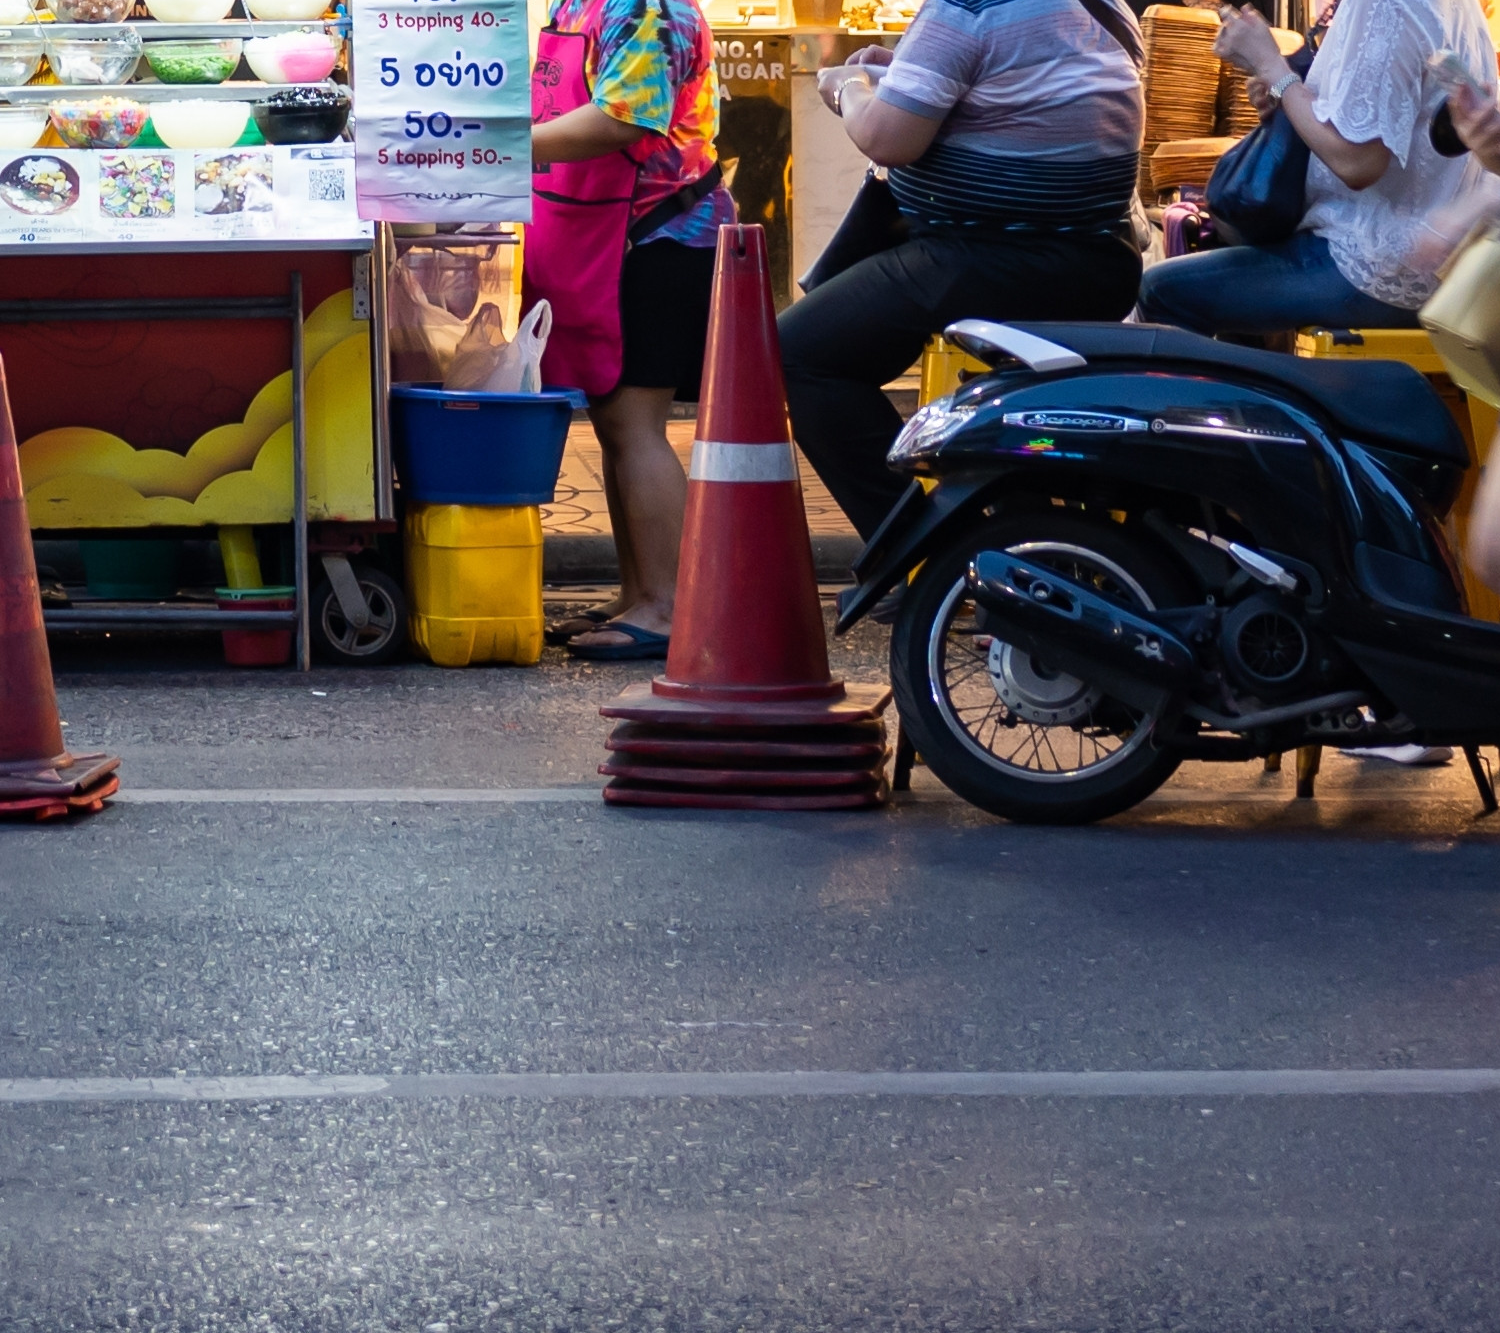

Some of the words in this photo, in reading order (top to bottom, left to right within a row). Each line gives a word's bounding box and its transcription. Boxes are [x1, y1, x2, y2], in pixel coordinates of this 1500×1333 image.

[378, 13, 389, 29] 3
[395, 12, 464, 32] topping
[470, 12, 510, 28] 40.-
[380, 57, 400, 87] 5
[414, 51, 504, 87] อย่าง
[720, 63, 786, 80] UGAR
[404, 111, 482, 139] 50.-
[378, 150, 389, 165] 5
[396, 149, 465, 169] topping
[471, 149, 512, 165] 50.-
[19, 233, 36, 242] 40
